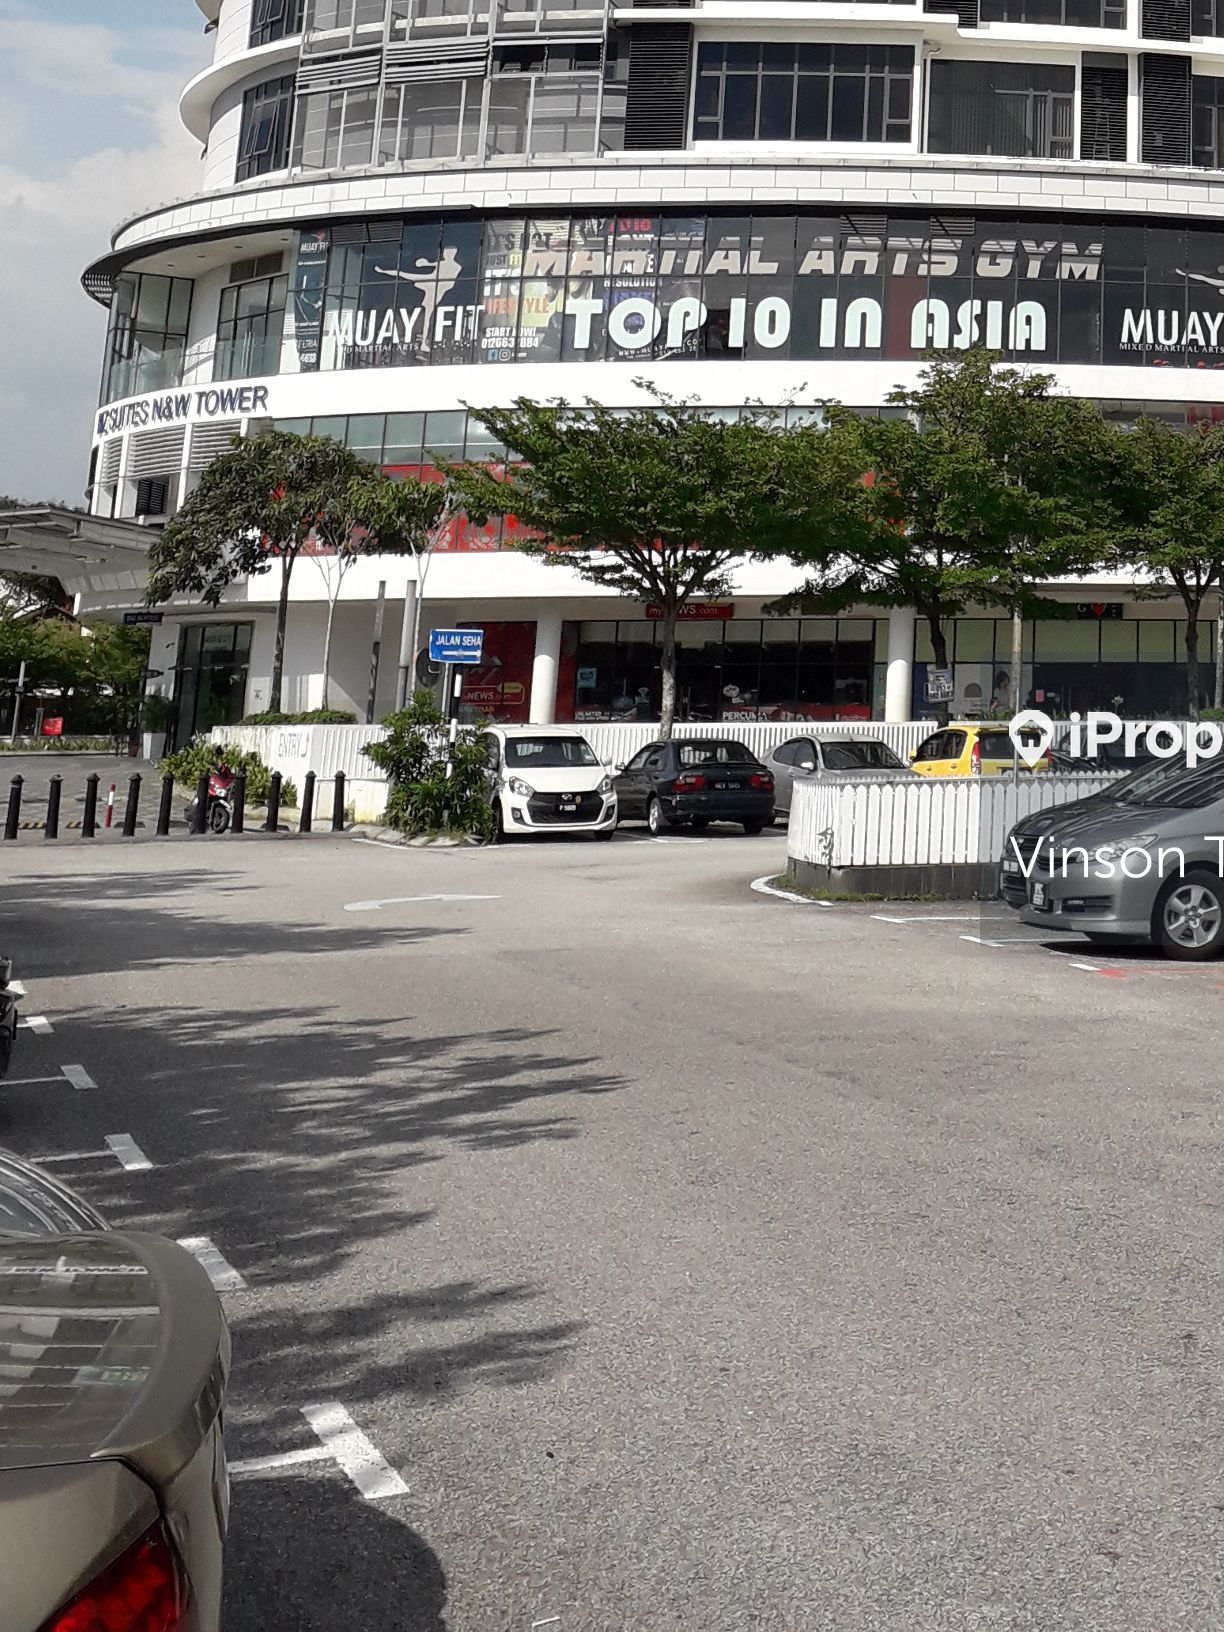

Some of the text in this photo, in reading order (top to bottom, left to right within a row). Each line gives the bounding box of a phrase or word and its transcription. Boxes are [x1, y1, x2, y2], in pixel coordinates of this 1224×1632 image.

[521, 236, 779, 277] MARTIAL
[798, 236, 963, 277] ARTS
[976, 239, 1105, 281] GYM
[328, 304, 485, 347] MUAY FIT
[565, 297, 708, 349] TOP
[728, 297, 792, 349] 10
[910, 298, 1047, 351] ASIA
[1120, 308, 1224, 347] MUAY
[1119, 343, 1153, 352] MIXED
[1154, 344, 1199, 353] MARTIAL
[109, 399, 150, 432] SUITES
[152, 392, 192, 421] N&W
[195, 385, 269, 416] TOWER
[435, 635, 461, 646] JALAN
